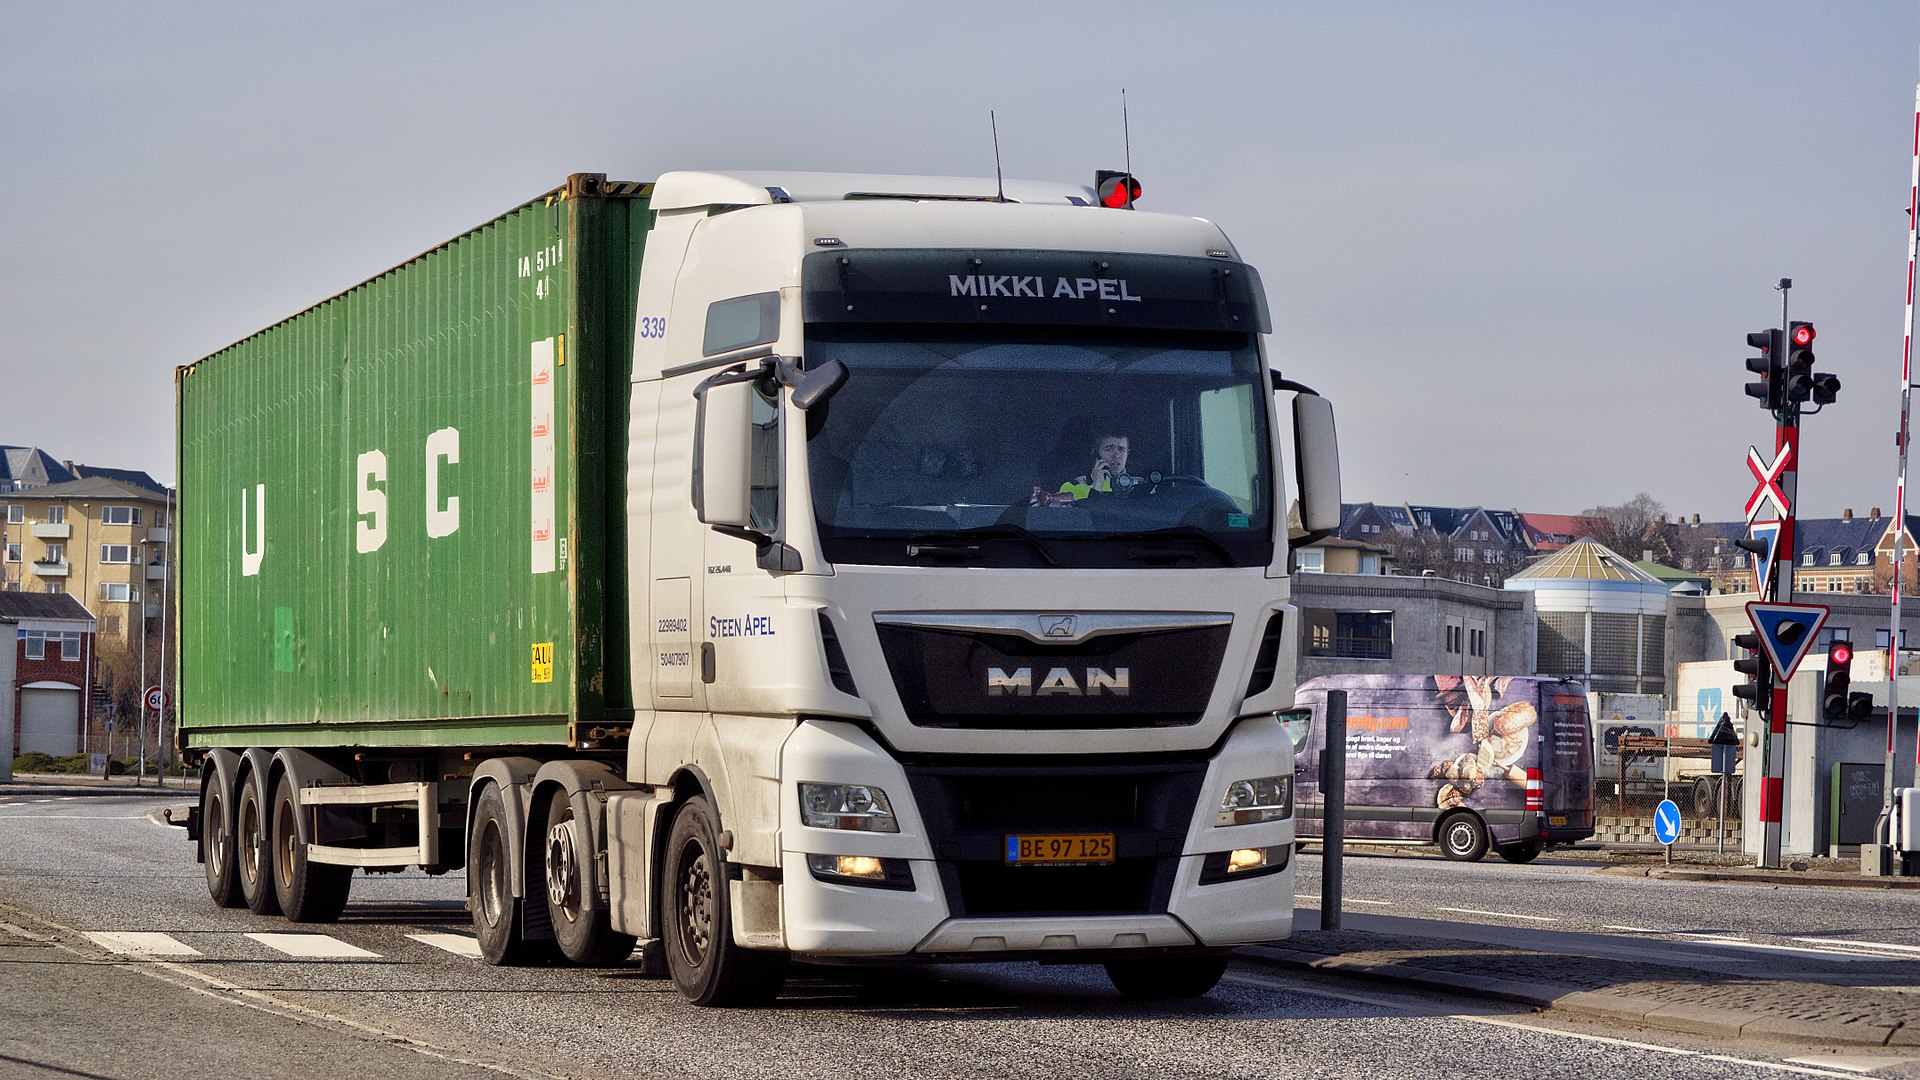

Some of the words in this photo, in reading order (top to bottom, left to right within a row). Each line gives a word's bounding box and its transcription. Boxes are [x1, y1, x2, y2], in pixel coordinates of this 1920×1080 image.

[948, 275, 1045, 297] MIKKI
[1052, 276, 1142, 302] APEL
[641, 317, 666, 338] 339
[710, 615, 742, 638] STEEN
[744, 613, 776, 637] APEL
[987, 667, 1130, 696] MAN
[1021, 840, 1045, 858] BE
[1050, 839, 1073, 858] 97
[1079, 839, 1110, 857] 125
